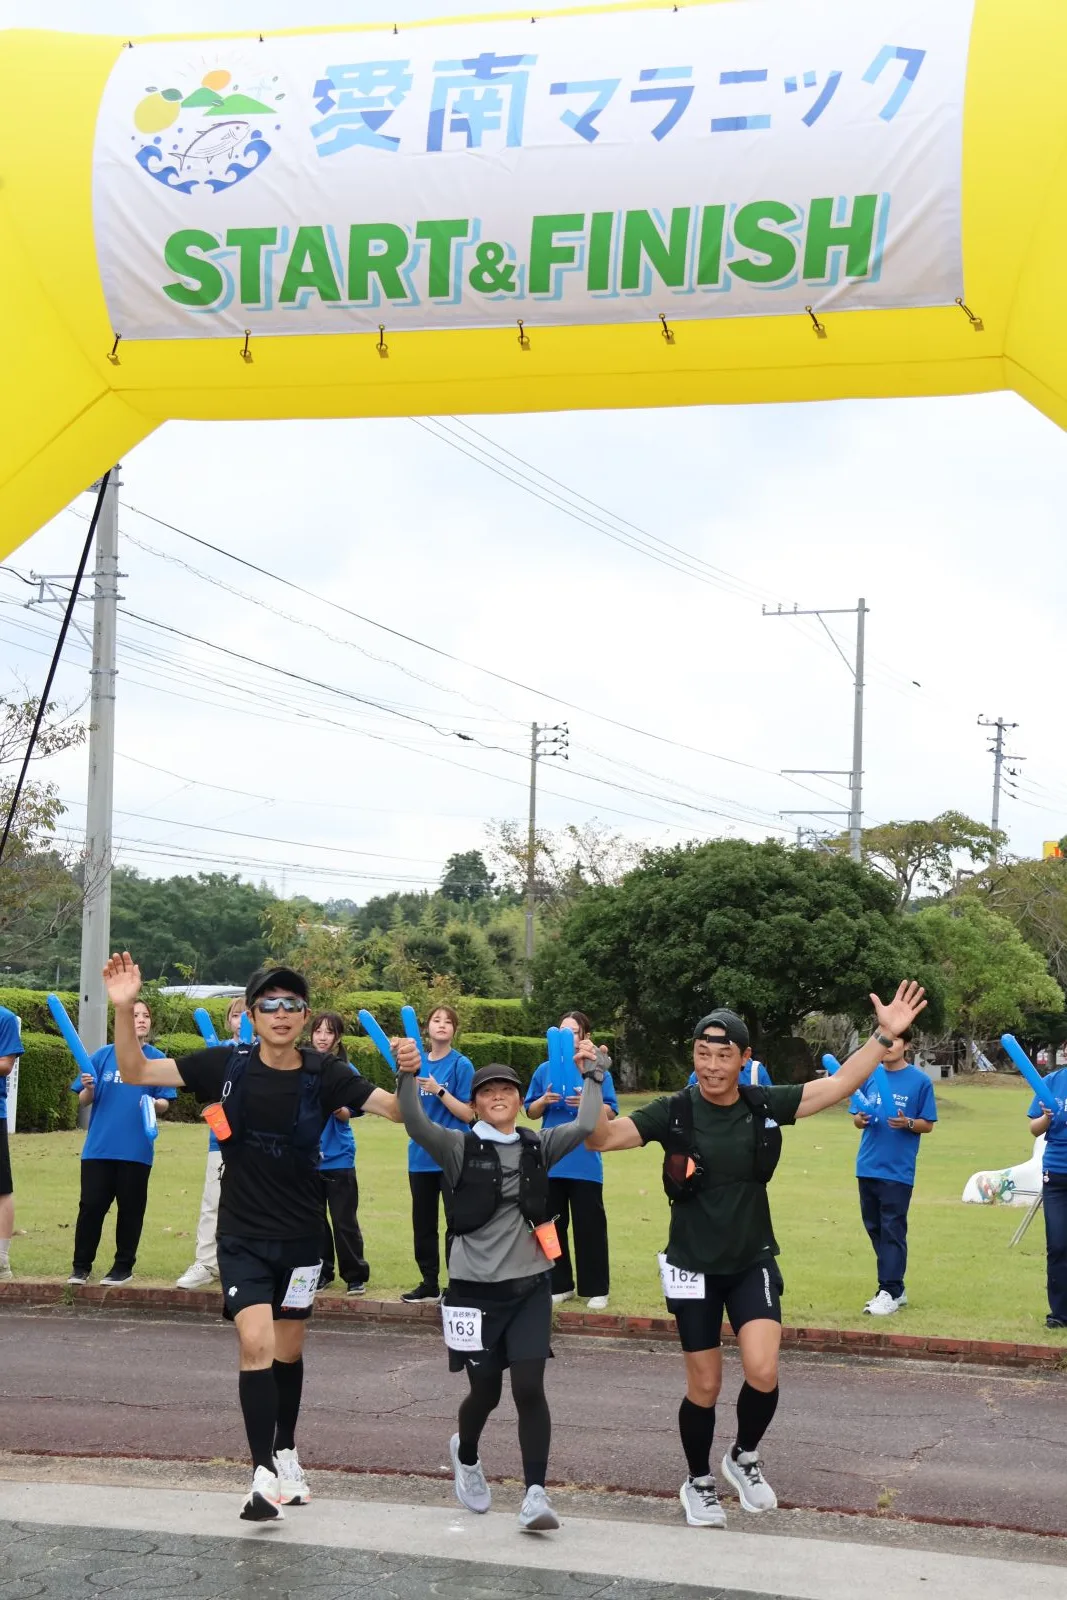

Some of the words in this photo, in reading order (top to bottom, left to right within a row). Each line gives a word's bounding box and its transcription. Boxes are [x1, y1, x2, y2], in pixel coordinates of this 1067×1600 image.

[308, 44, 928, 158] 愛南マラニック
[161, 192, 890, 312] START&FINISH
[670, 1268, 698, 1282] 162
[764, 1287, 772, 1306] UNDER
[449, 1321, 474, 1336] 163
